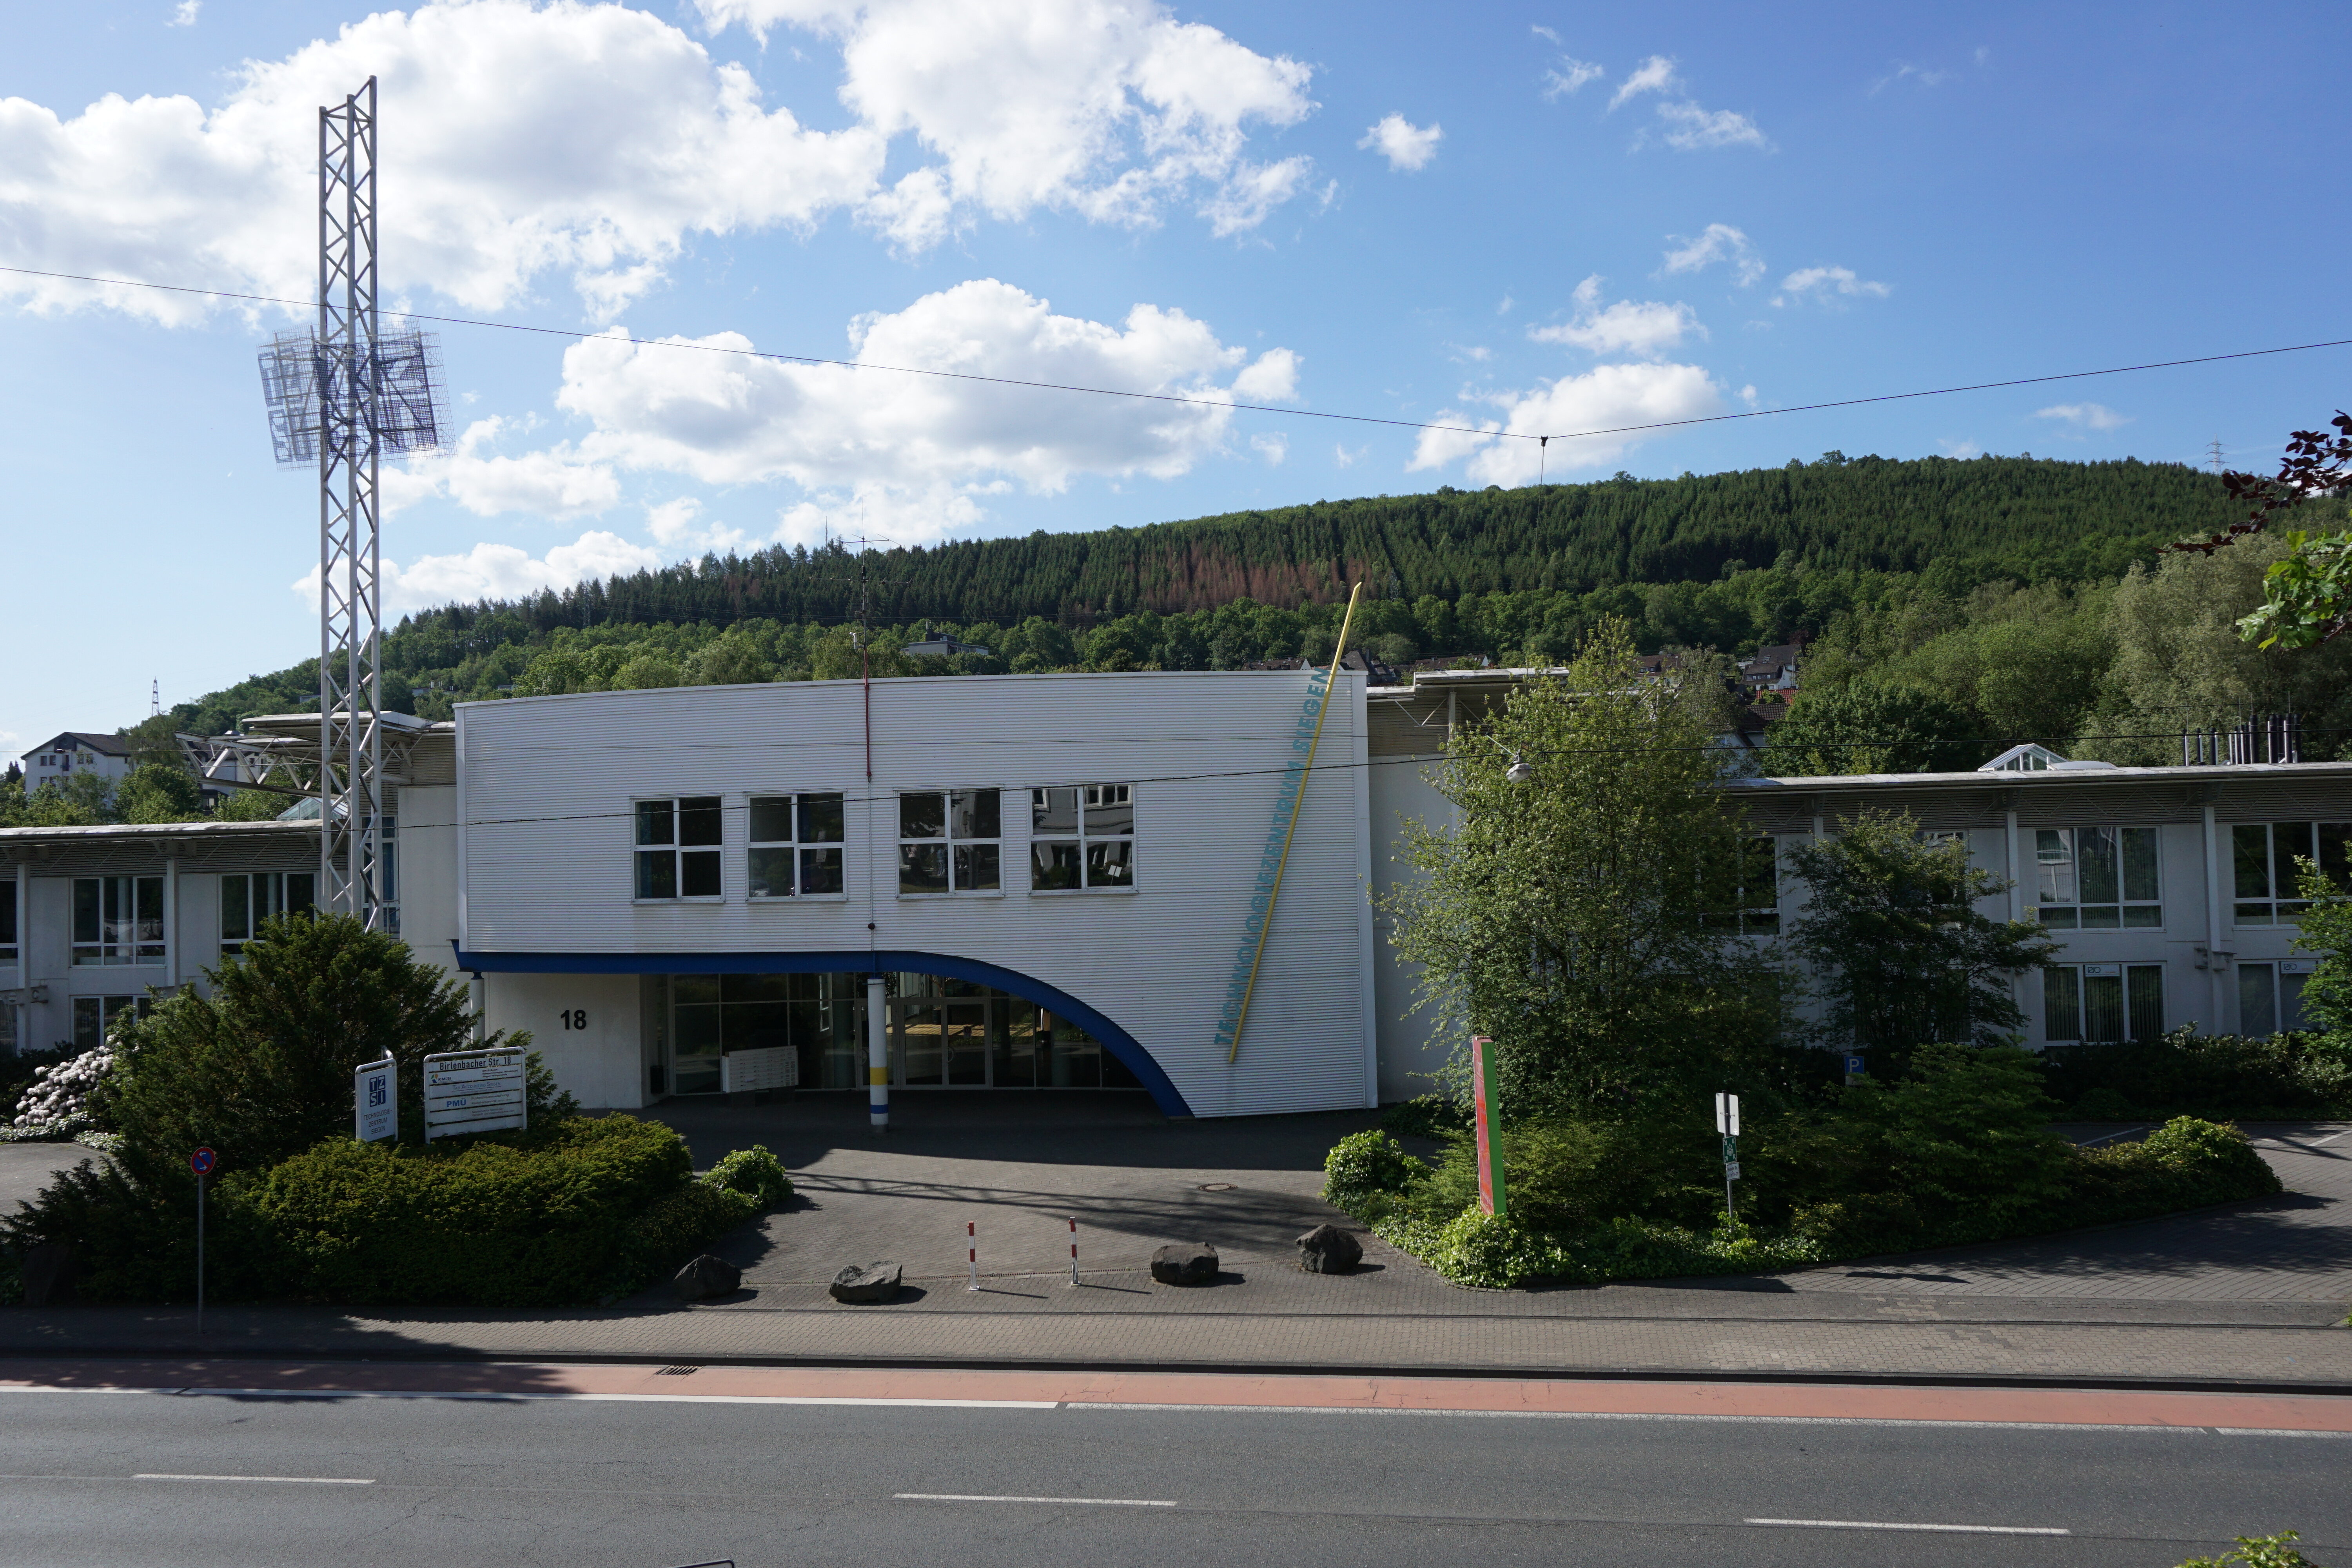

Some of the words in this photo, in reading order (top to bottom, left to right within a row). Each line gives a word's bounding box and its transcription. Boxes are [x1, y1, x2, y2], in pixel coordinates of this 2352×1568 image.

[1214, 760, 1305, 1044] TECHNOLOGIEZENTRUM
[1293, 666, 1331, 753] SIEGEN
[560, 1009, 587, 1030] 18
[439, 1060, 486, 1070] Birlenbacher
[1849, 1058, 1860, 1073] P
[370, 1076, 385, 1091] TZ
[446, 1098, 466, 1107] PMÜ
[363, 1109, 392, 1120] TECHNOLOGIE-
[368, 1117, 387, 1127] ZENTRUM
[371, 1125, 385, 1134] SIEGEN
